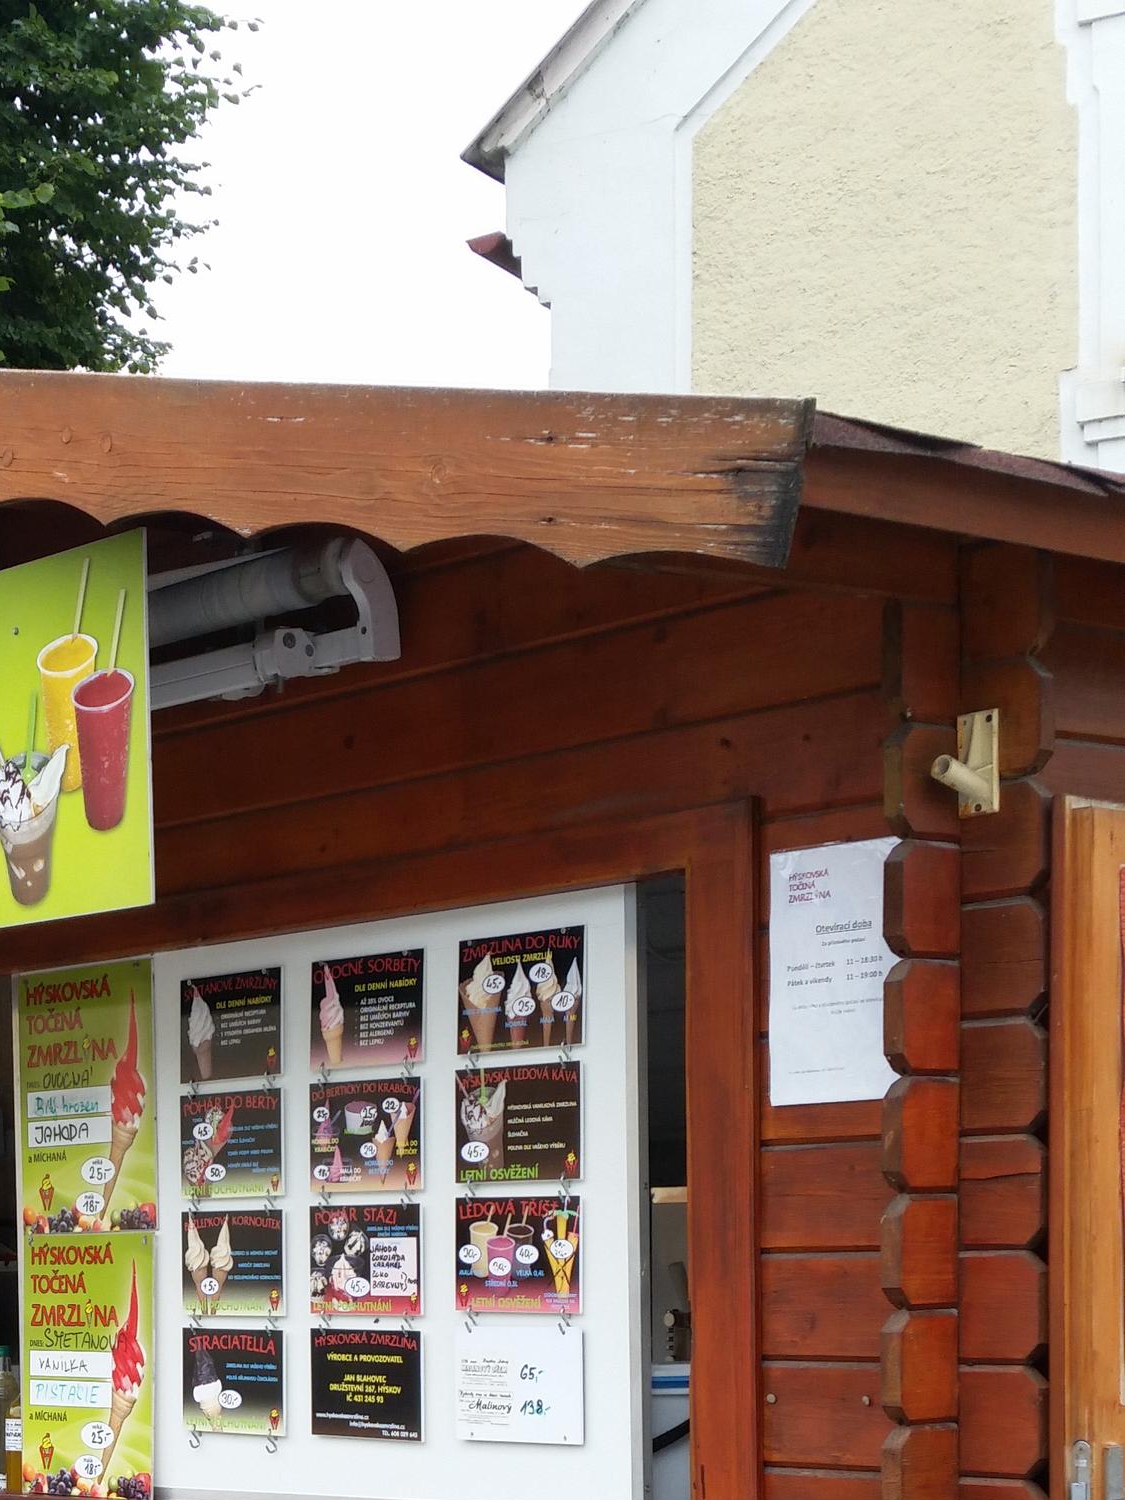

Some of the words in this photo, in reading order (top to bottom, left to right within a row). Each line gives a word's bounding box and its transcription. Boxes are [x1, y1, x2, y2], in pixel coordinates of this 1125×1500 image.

[816, 922, 850, 934] Otevírací
[852, 919, 872, 929] doba
[462, 938, 522, 962] ZMRZLINA
[526, 935, 545, 948] DO
[549, 933, 580, 949] RUKY
[368, 957, 420, 974] SORBETY
[26, 973, 111, 1007] HÝSKOVSKÁ
[368, 979, 387, 990] DENNÍ
[389, 977, 417, 988] NABÍDKY
[787, 978, 803, 987] Pátek
[810, 976, 833, 986] víkendy
[26, 1006, 83, 1035] TOČENÁ
[514, 1066, 549, 1080] LEDOVÁ
[552, 1067, 577, 1082] KÁVA
[363, 1084, 375, 1093] DO
[183, 1096, 222, 1117] POHÁR
[225, 1096, 243, 1109] DO
[246, 1095, 279, 1110] BERTY
[35, 1122, 89, 1144] JAHODA
[33, 1150, 67, 1163] MÍCHANÁ
[460, 1166, 487, 1181] LETNÍ
[490, 1163, 539, 1179] OSVĚŽENÍ
[364, 1207, 397, 1224] STÁZI
[459, 1199, 515, 1220] LEDOVÁ
[232, 1216, 280, 1229] KORNOUTEK
[31, 1242, 114, 1265] HÝSKOVSKÁ
[30, 1269, 87, 1294] TOČENÁ
[189, 1334, 276, 1356] STRACIATELLA
[315, 1331, 367, 1347] HÝSKOVSKÁ
[370, 1334, 417, 1351] ZMRZLINA
[39, 1358, 88, 1373] VANILKA
[327, 1351, 352, 1362] VÝROBCE
[359, 1354, 403, 1364] PROVOZOVATEL
[344, 1374, 355, 1382] JAN
[356, 1374, 386, 1383] BLAHOVEC
[35, 1383, 99, 1403] PISTACIE
[330, 1383, 364, 1392] DRUŽSTEVNÍ
[377, 1384, 401, 1394] HÝSKOV
[35, 1410, 67, 1421] MÍCHANÁ
